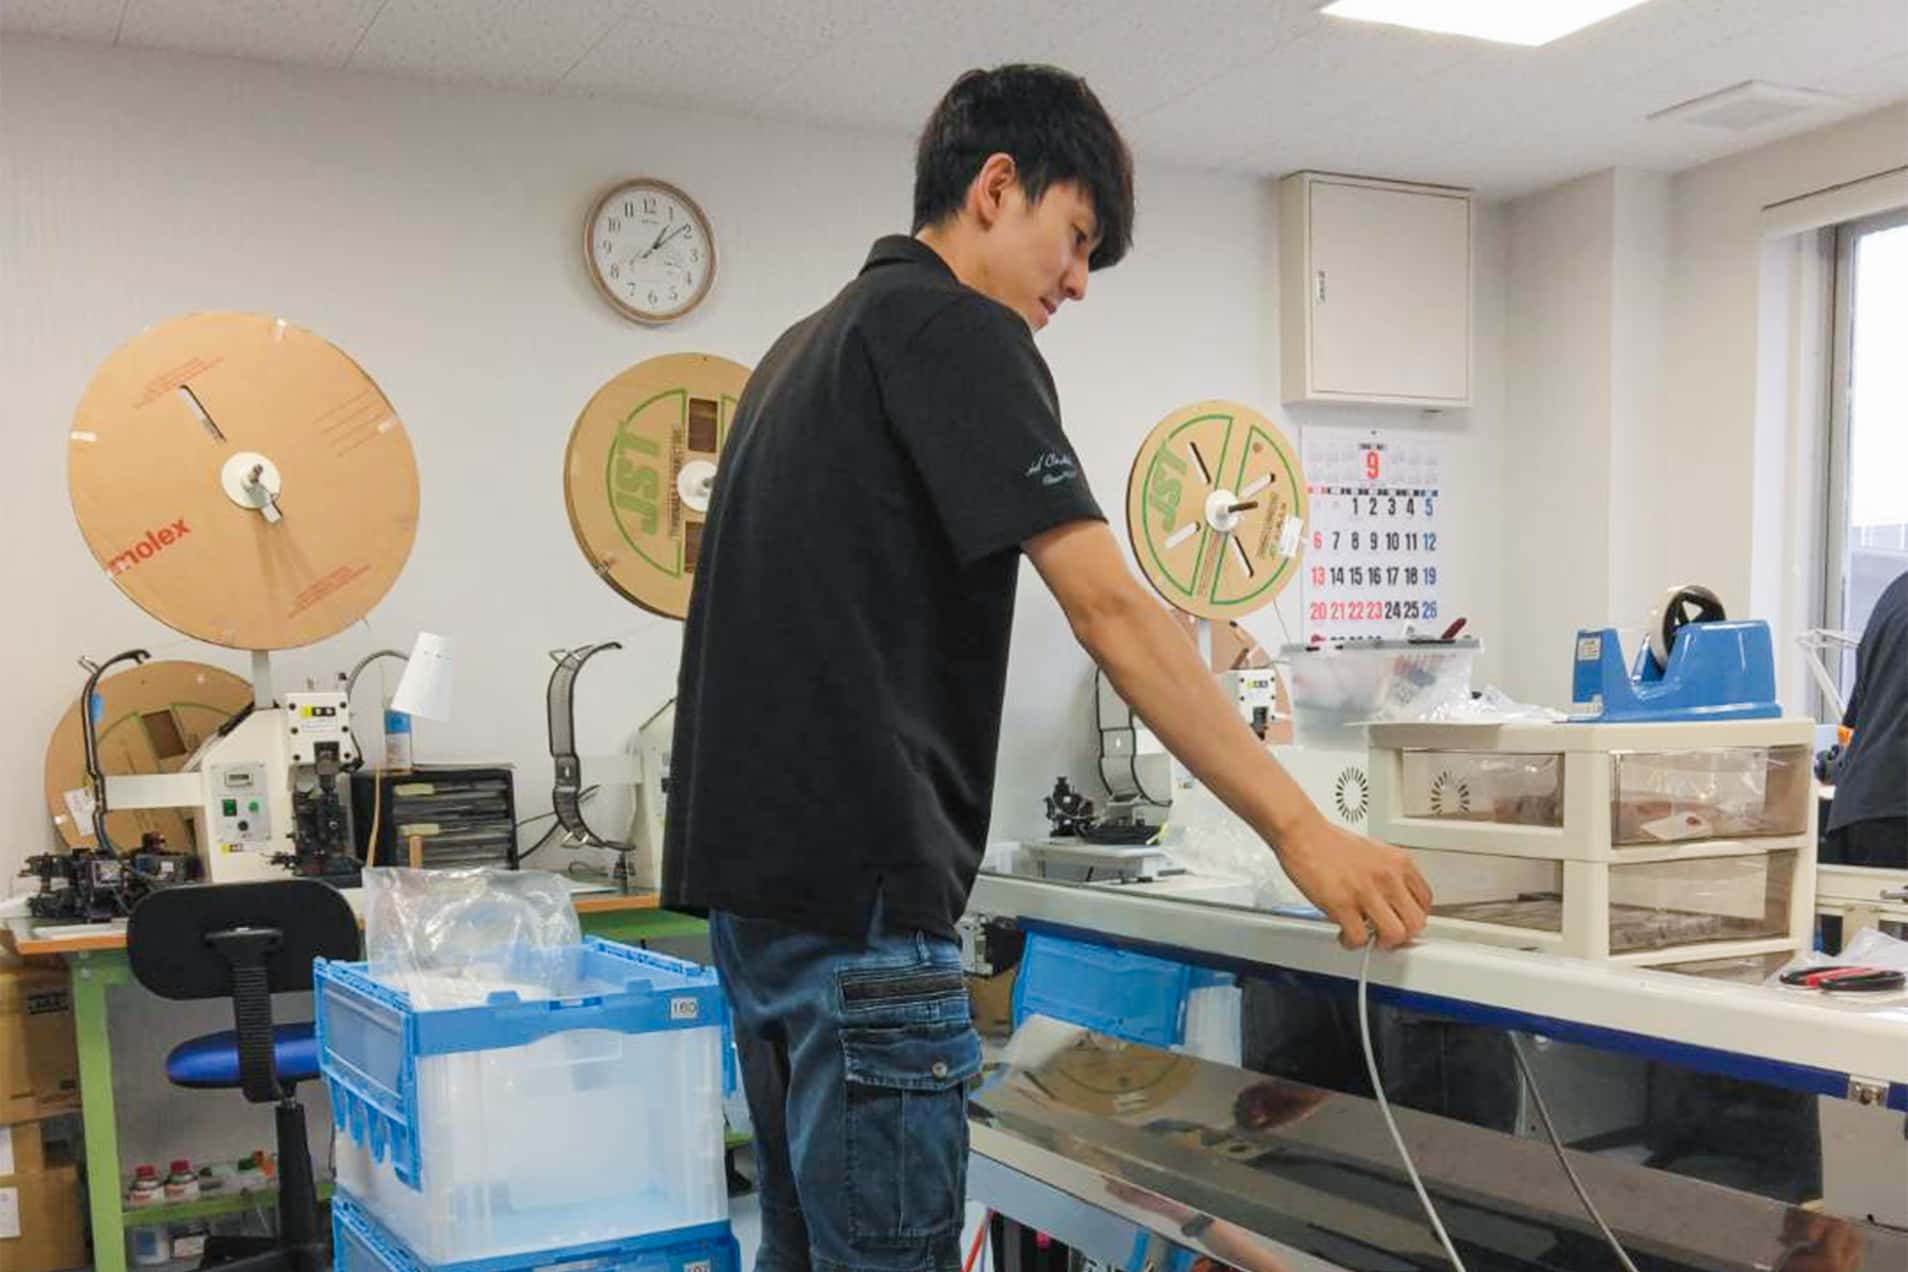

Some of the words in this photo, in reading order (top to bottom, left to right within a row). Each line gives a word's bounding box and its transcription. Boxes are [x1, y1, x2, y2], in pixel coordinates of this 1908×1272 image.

[625, 202, 634, 217] 11
[644, 198, 657, 214] 12
[608, 217, 621, 232] 10
[603, 239, 612, 254] 9
[689, 248, 699, 263] 3
[610, 263, 620, 279] 8
[625, 282, 636, 297] 7
[648, 290, 658, 305] 6
[1367, 449, 1379, 480] 9
[615, 422, 660, 536] JST
[1352, 497, 1359, 516] 1
[1369, 497, 1377, 516] 2
[1388, 497, 1396, 516] 3
[1406, 497, 1415, 516] 4
[1425, 498, 1434, 517] 5
[107, 518, 190, 576] molex
[1312, 531, 1323, 550] 6
[1331, 531, 1341, 551] 7
[1351, 531, 1360, 551] 8
[1369, 531, 1378, 551] 9
[1385, 532, 1400, 551] 10
[1405, 532, 1418, 551] 11
[1423, 532, 1437, 551] 12
[1311, 566, 1325, 586] 13
[1330, 566, 1345, 585] 14
[1349, 566, 1363, 586] 15
[1368, 566, 1382, 585] 16
[1386, 567, 1399, 585] 17
[1404, 567, 1418, 585] 18
[1423, 567, 1437, 585] 19
[1310, 601, 1327, 620] 20
[1330, 601, 1345, 620] 21
[1348, 601, 1364, 620] 22
[1366, 601, 1383, 620] 23
[1384, 601, 1401, 620] 24
[1403, 601, 1419, 620] 25
[1422, 601, 1437, 620] 26
